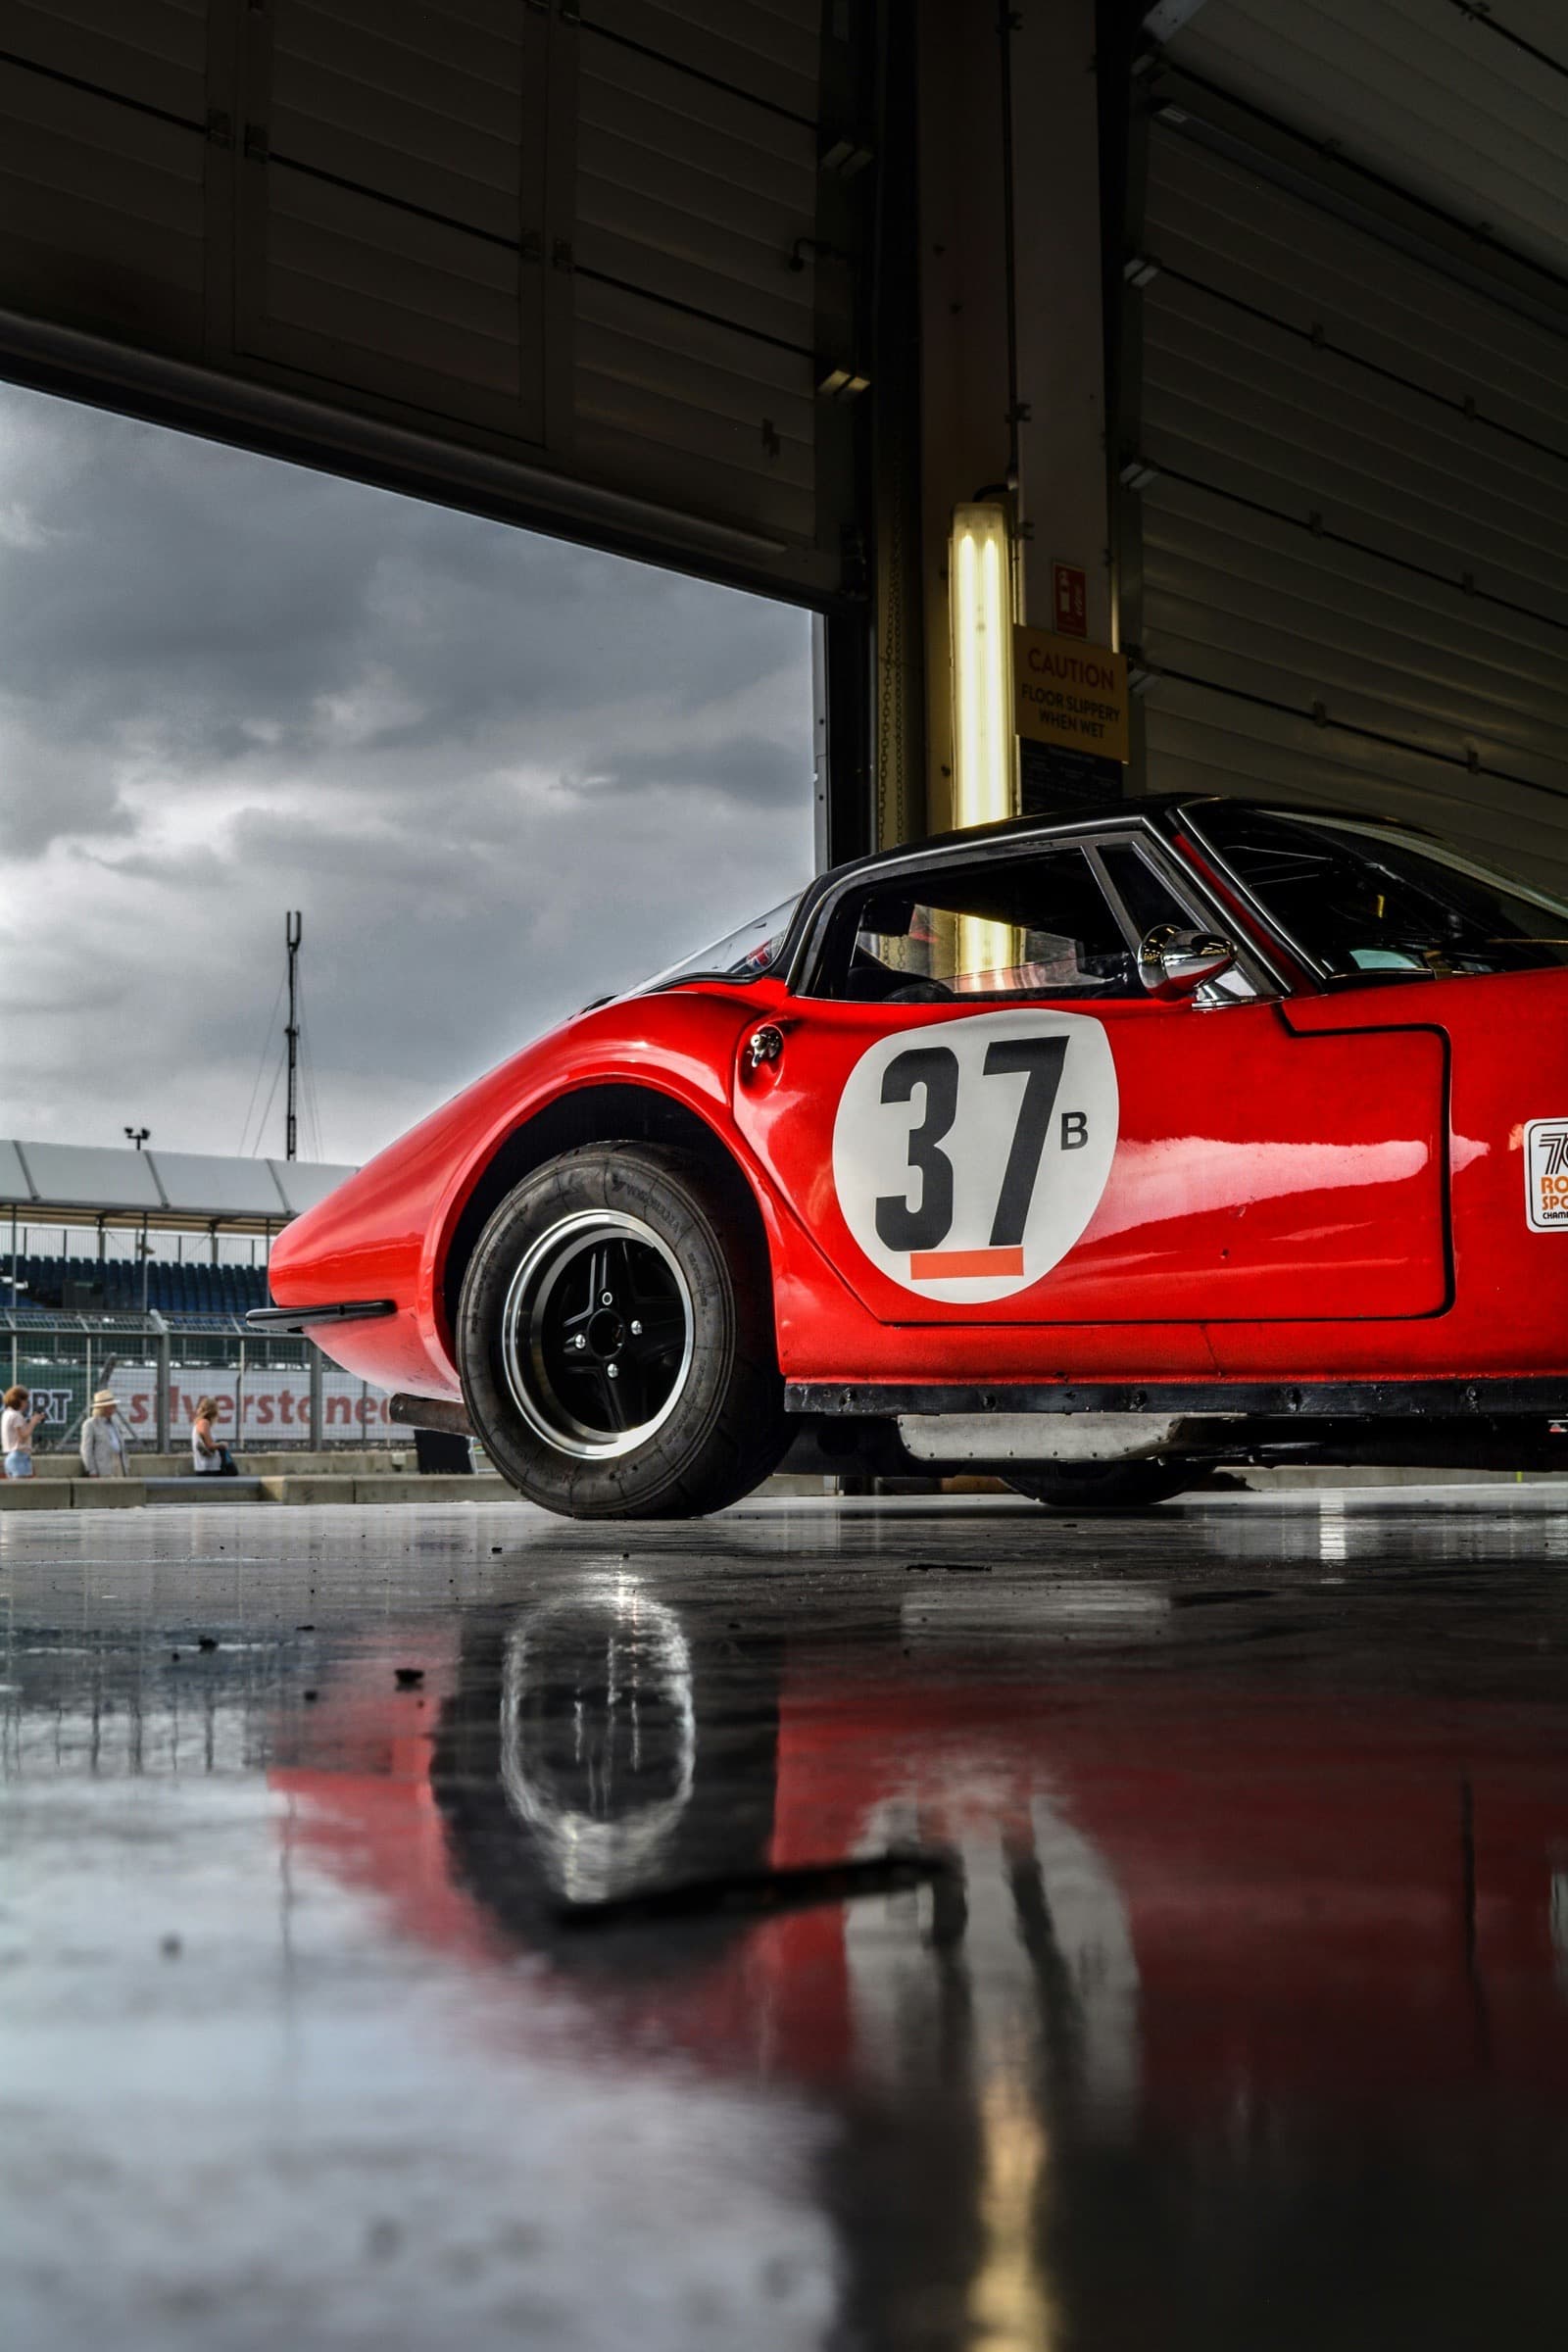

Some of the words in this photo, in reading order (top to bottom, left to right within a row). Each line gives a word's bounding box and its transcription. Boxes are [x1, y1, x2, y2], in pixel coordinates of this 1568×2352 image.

[1027, 648, 1114, 691] CAUTION
[1021, 683, 1064, 709] FLOOR
[1066, 696, 1121, 722] SLIPPERY
[1039, 710, 1078, 732] WHEN
[1080, 719, 1105, 739] WET
[875, 1035, 1070, 1252] 37
[1060, 1111, 1089, 1151] B
